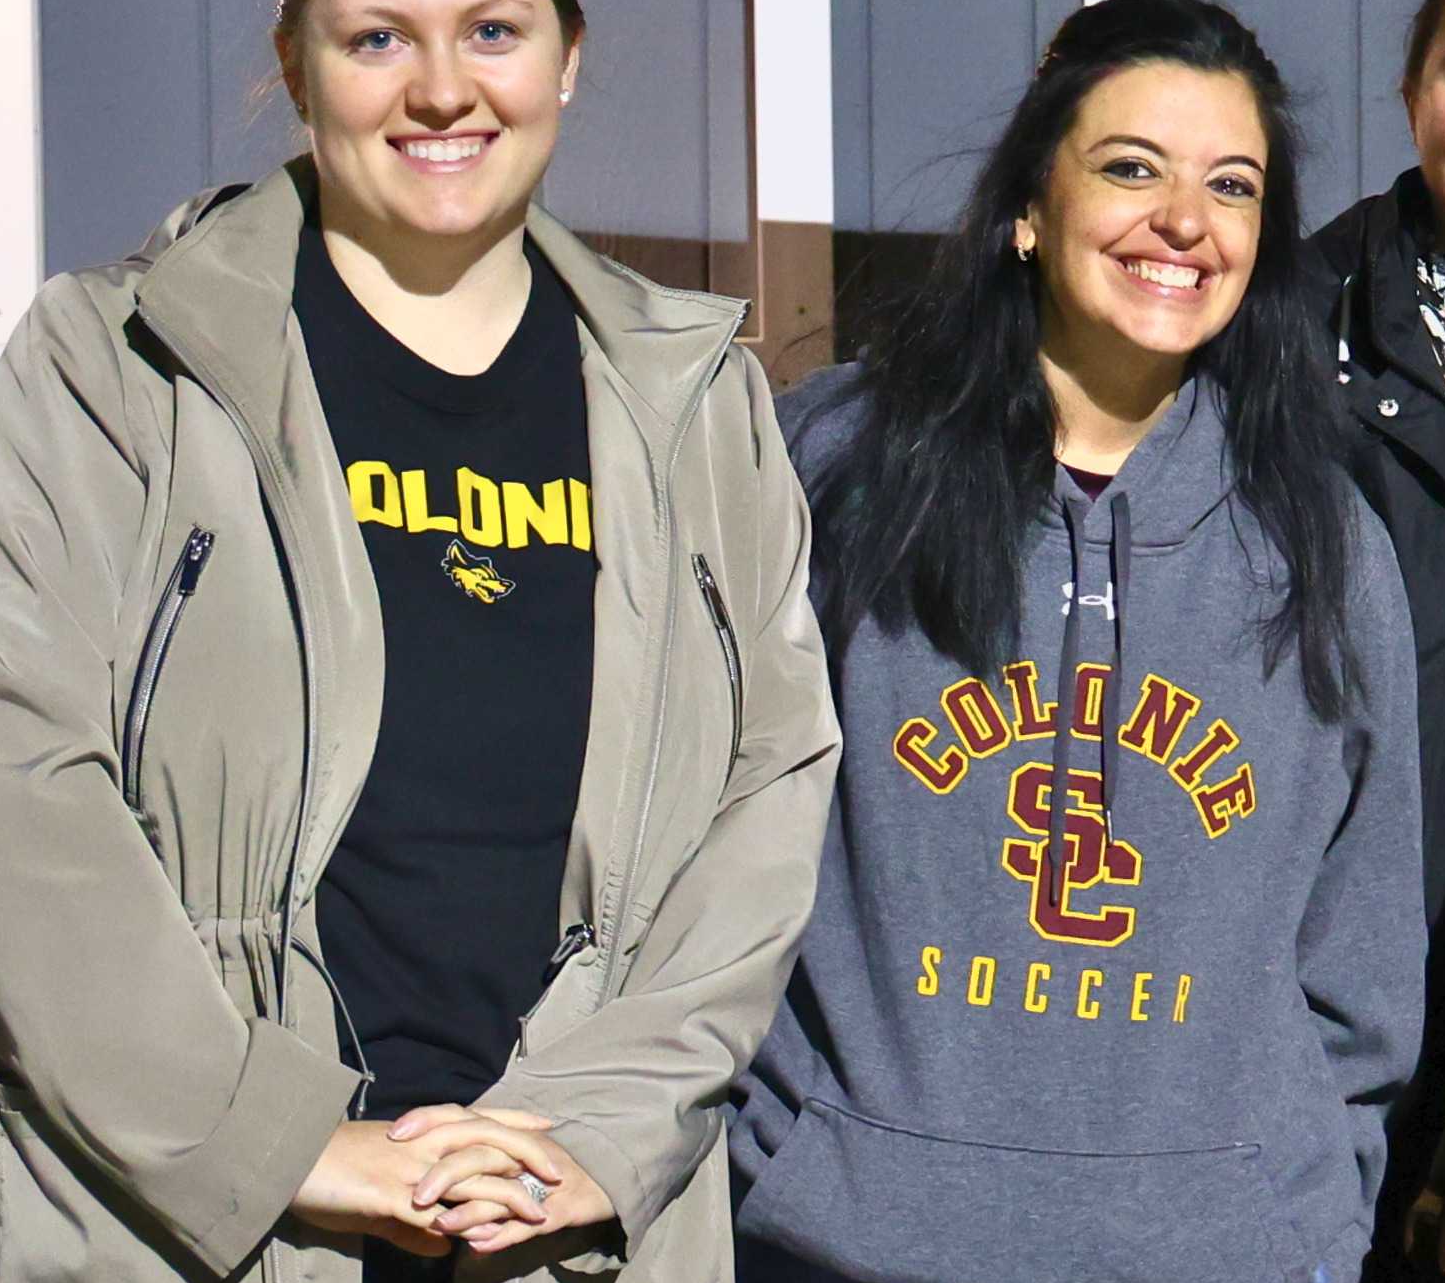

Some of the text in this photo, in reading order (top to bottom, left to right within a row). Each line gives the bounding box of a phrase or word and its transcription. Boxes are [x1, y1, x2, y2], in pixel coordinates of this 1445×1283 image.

[346, 460, 592, 552] OLONI
[893, 659, 1257, 839] COLONIE
[916, 945, 1193, 1023] SOCCER
